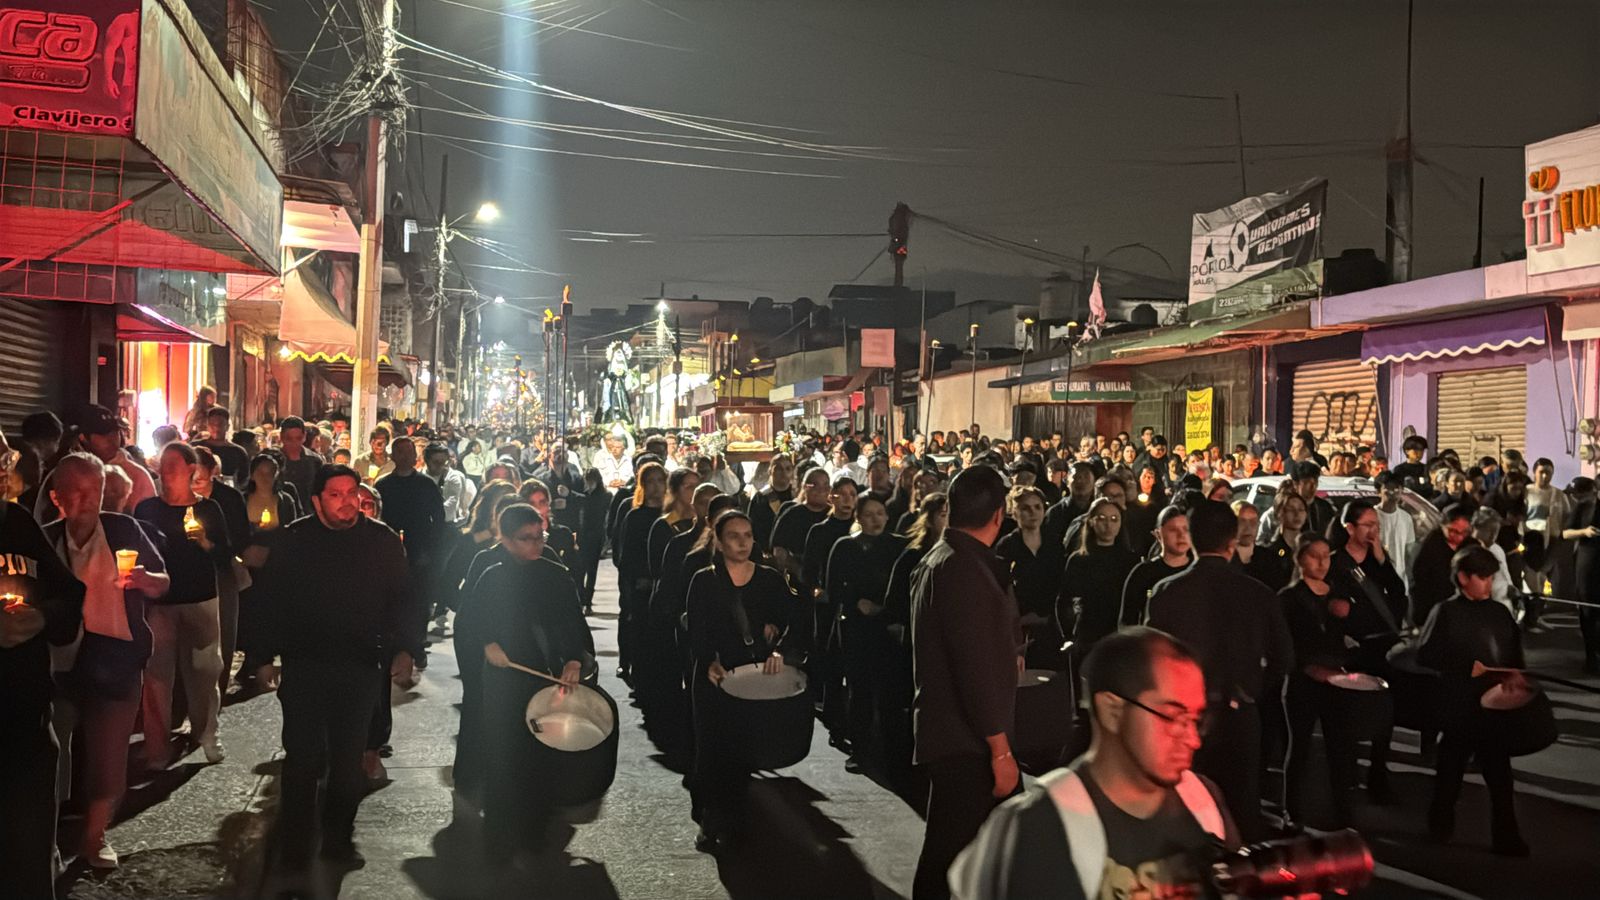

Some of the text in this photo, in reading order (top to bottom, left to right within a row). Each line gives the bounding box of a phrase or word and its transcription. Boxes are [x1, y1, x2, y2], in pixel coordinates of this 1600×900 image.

[14, 106, 117, 128] Clavijero
[1250, 203, 1310, 241] UNIFORMES
[1095, 381, 1132, 392] FAMILIAR
